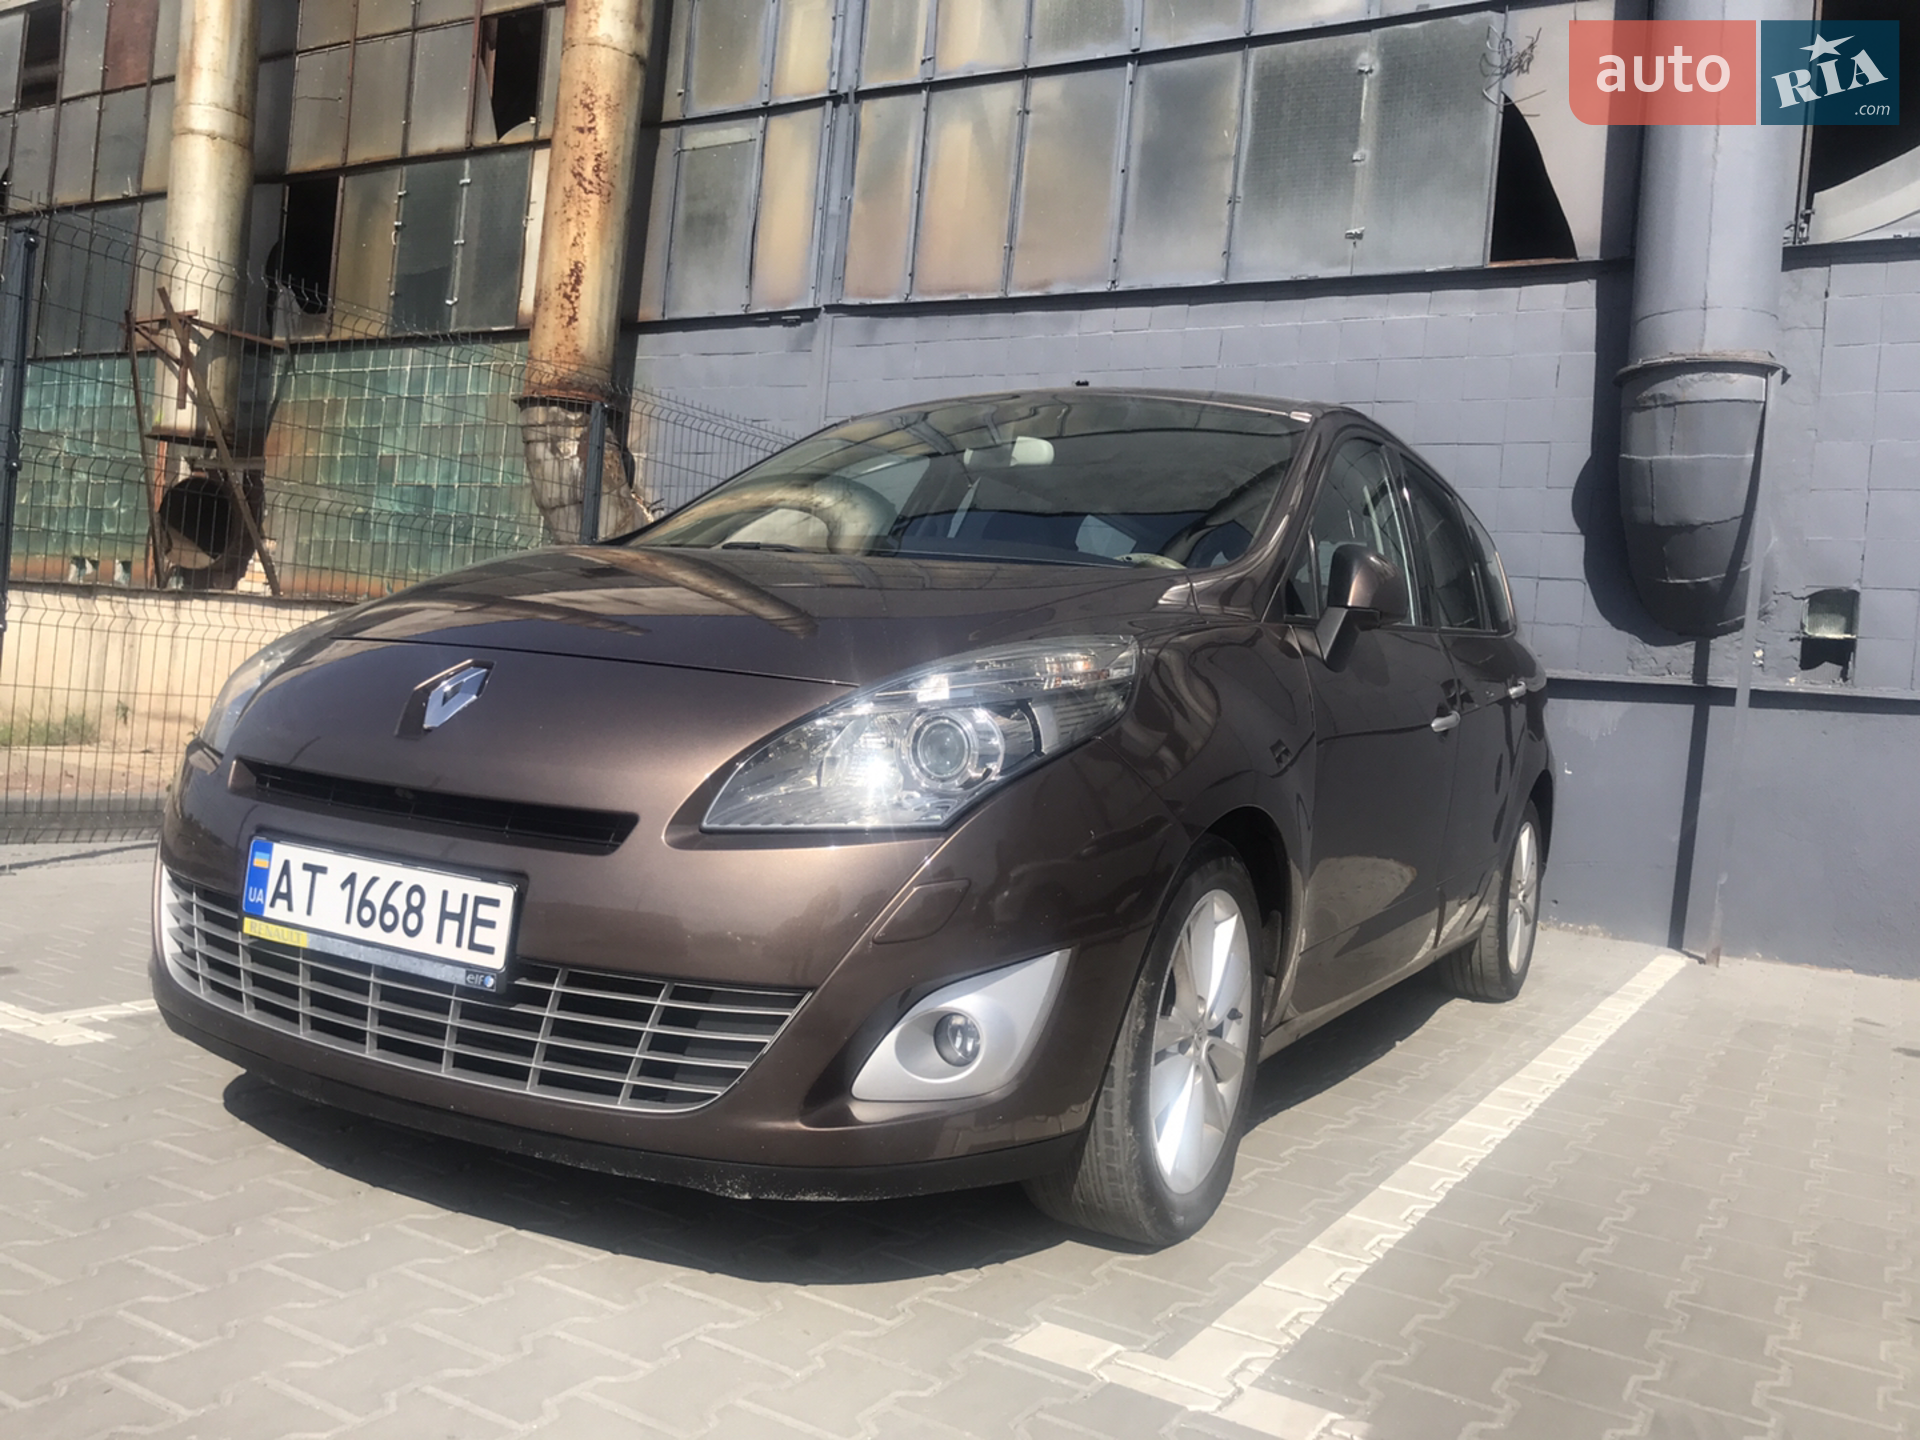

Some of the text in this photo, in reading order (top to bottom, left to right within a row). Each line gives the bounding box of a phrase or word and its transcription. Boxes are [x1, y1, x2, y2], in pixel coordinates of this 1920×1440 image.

[249, 886, 264, 905] UA
[269, 859, 500, 955] AT 1668 HE
[250, 921, 303, 944] RENAULT
